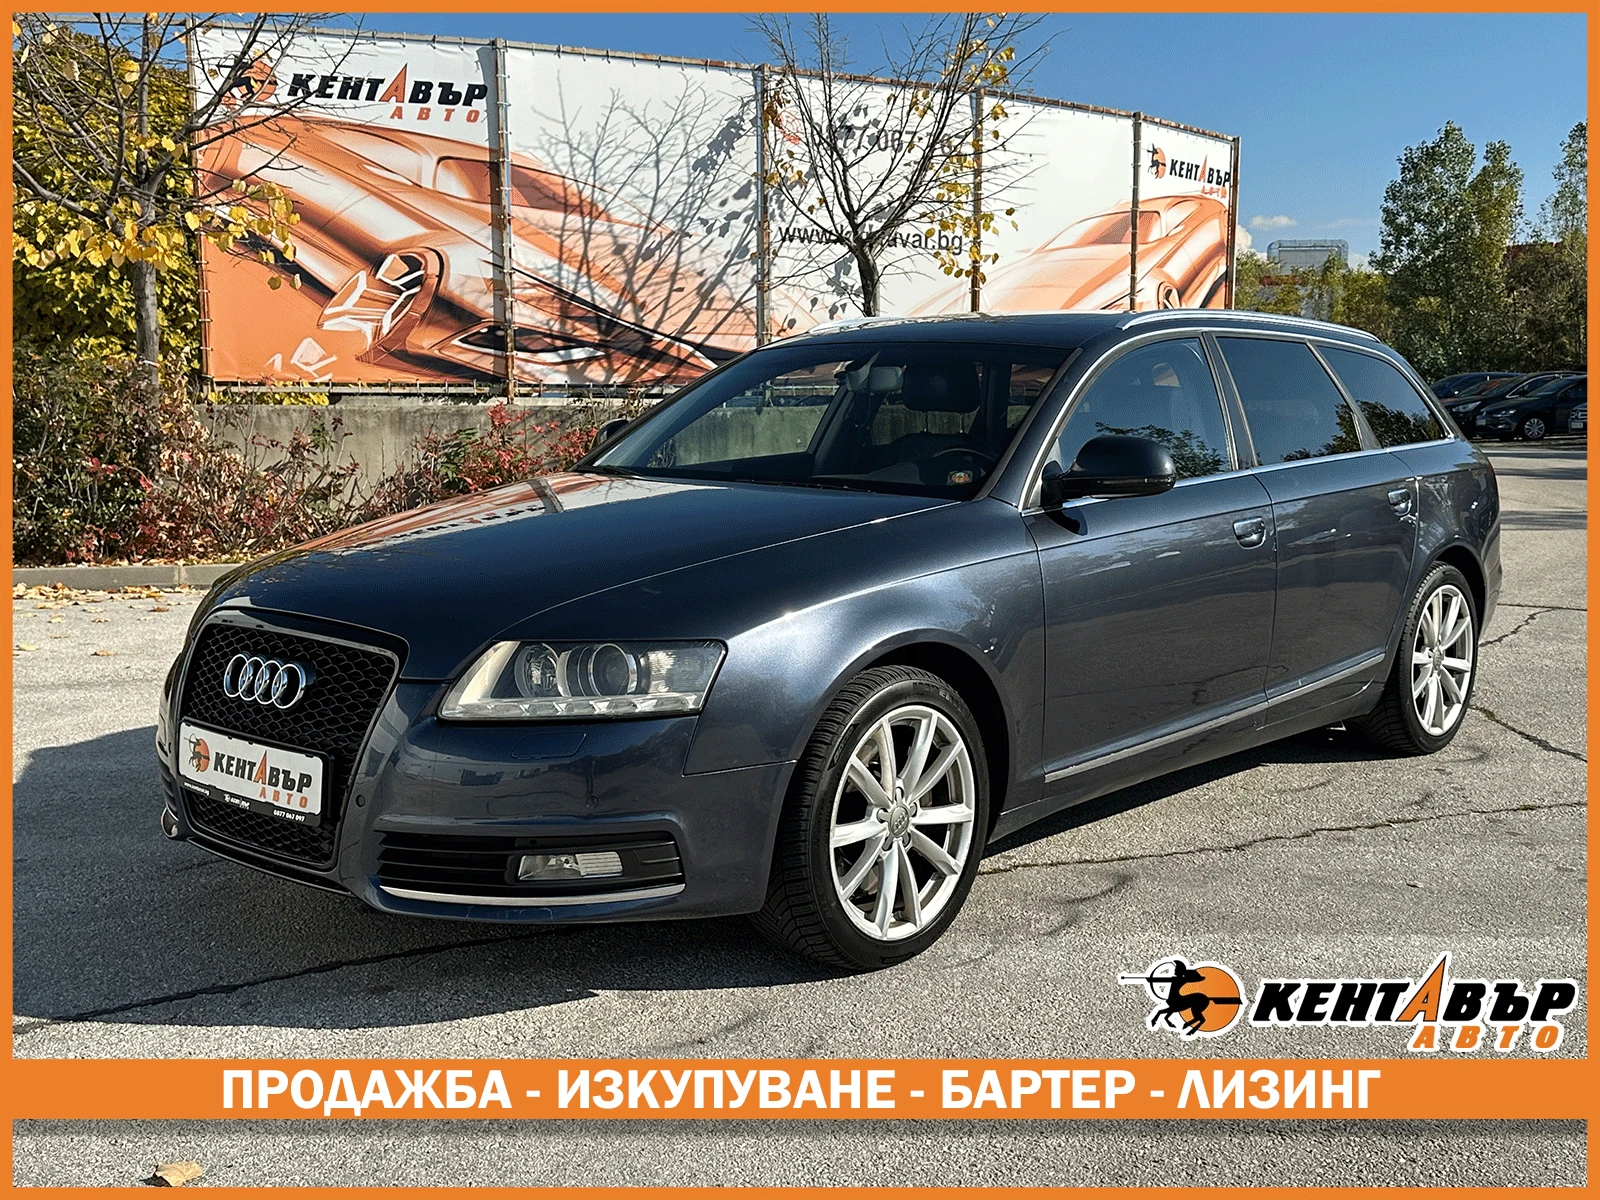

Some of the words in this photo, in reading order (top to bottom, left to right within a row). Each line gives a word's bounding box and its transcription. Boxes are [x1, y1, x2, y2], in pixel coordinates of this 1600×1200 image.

[287, 63, 488, 107] КЕНТАВЪР
[390, 106, 481, 123] АВТО
[1169, 154, 1231, 187] КЕНТАВЪР
[213, 750, 312, 793] КЕНТАВЪР
[259, 787, 308, 809] АВТО
